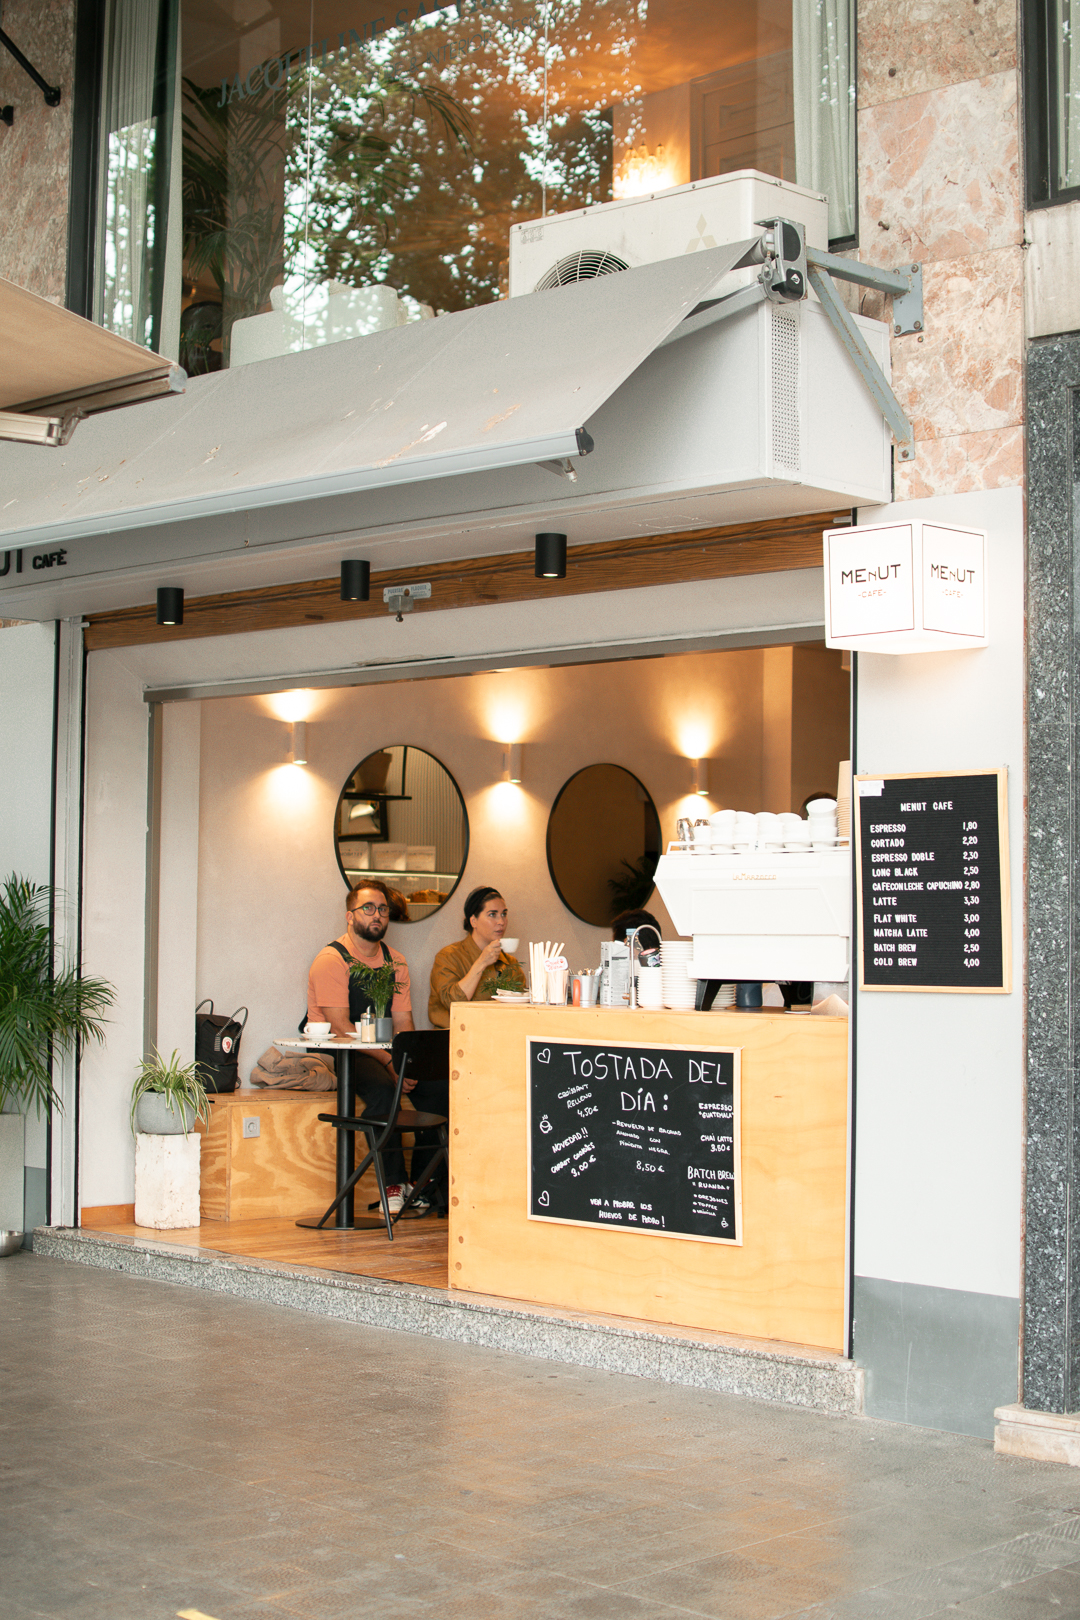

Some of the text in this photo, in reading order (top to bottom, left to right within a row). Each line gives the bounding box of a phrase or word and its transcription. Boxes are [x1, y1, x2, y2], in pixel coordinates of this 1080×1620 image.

[410, 56, 420, 73] &
[426, 30, 492, 65] INTERIOR
[217, 16, 386, 108] JACQUELINE
[901, 801, 953, 811] MENUT CAFE
[870, 822, 977, 833] ESPRESSO 1,80
[871, 836, 978, 848] CORTADO 2,20
[871, 851, 978, 862] ESPRESSO DOBLE 2,30
[872, 866, 979, 877] LONG BLACK 2,50
[927, 881, 963, 890] CAPUCHINO
[964, 881, 980, 890] 2,80
[873, 896, 979, 906] LATTE 3,30
[874, 914, 979, 923] FLAT WHITE 3,00
[874, 929, 980, 938] MATCHA LATTE 4,00
[874, 943, 979, 953] BATCH BREW 2,50
[874, 958, 979, 968] COLD BREW 4,00
[563, 1051, 727, 1085] TOSTADA DEL
[698, 1102, 733, 1112] ESPRESSO
[649, 1136, 661, 1144] CON
[716, 1135, 734, 1143] LATTE
[687, 1165, 717, 1180] BATCH
[590, 1198, 602, 1206] VEN
[603, 1199, 610, 1207] A
[640, 1202, 653, 1211] LOS
[598, 1210, 623, 1220] HUEVOS
[628, 1213, 638, 1221] DE
